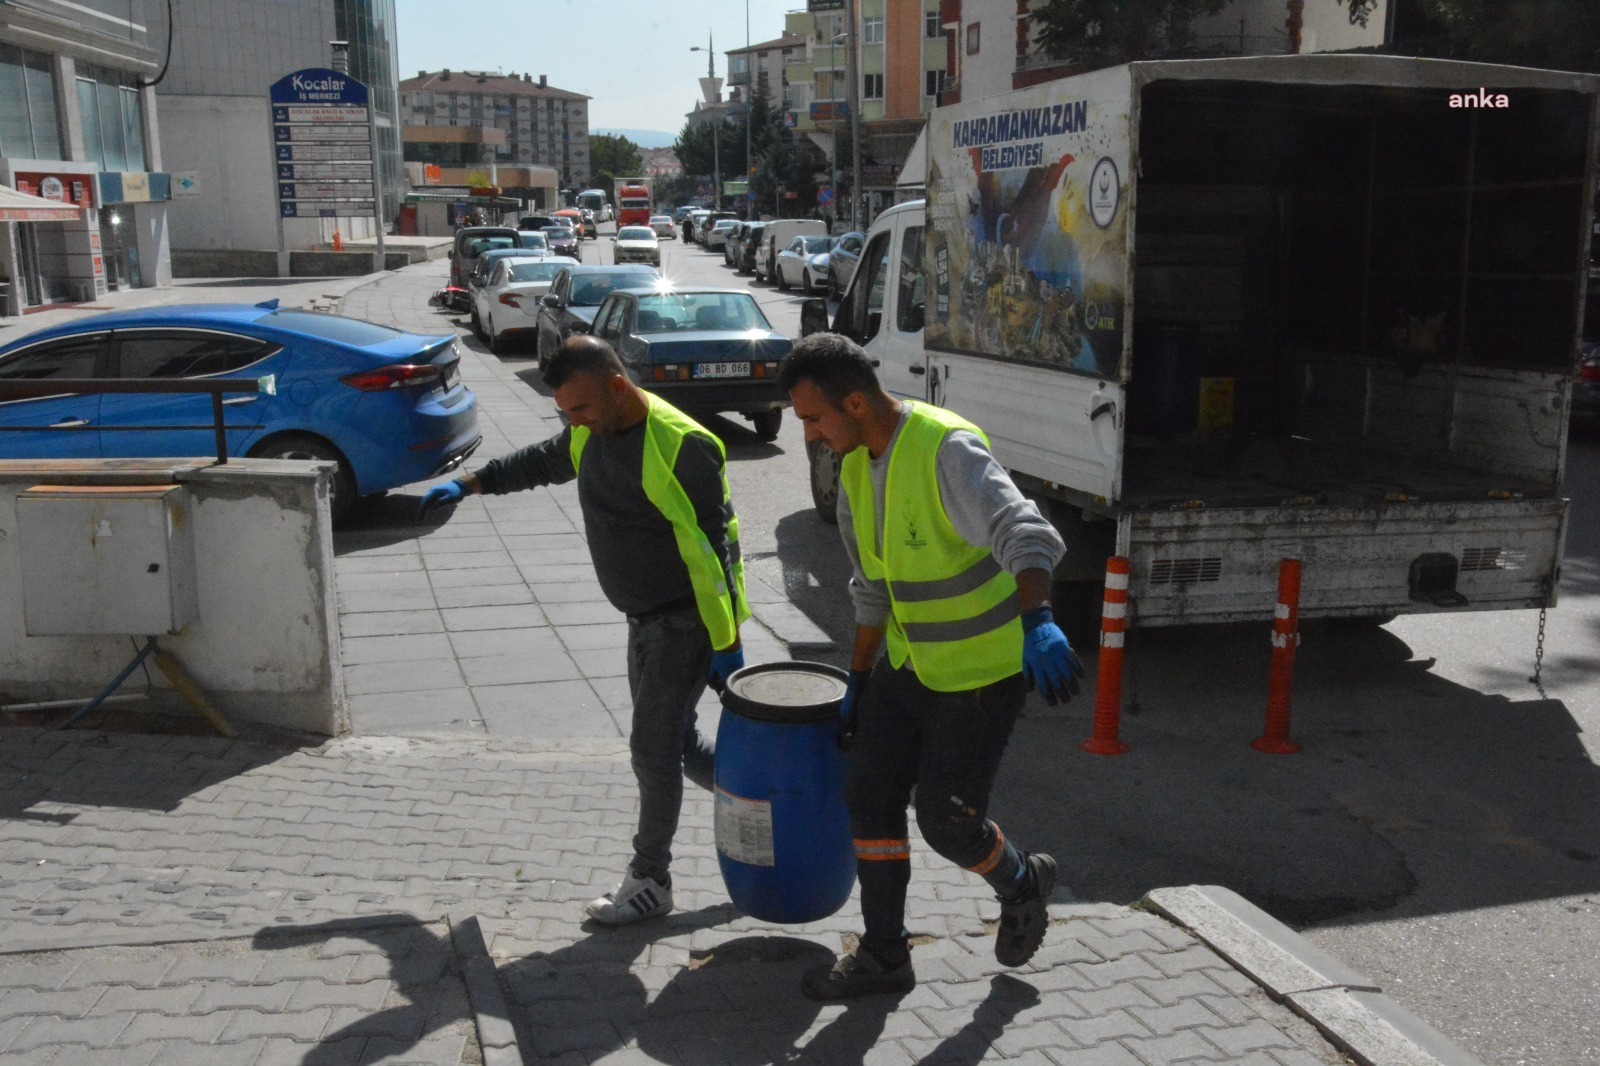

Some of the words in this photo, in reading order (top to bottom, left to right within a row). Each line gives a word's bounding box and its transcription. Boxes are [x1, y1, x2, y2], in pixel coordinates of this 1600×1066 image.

[292, 75, 345, 91] Kocalar
[309, 92, 341, 100] MERKEZİ
[953, 100, 1088, 149] KAHRAMANKAZAN
[982, 142, 1044, 171] BELEDİYESİ
[699, 365, 711, 374] 06
[715, 364, 727, 374] BD
[731, 363, 749, 373] 066
